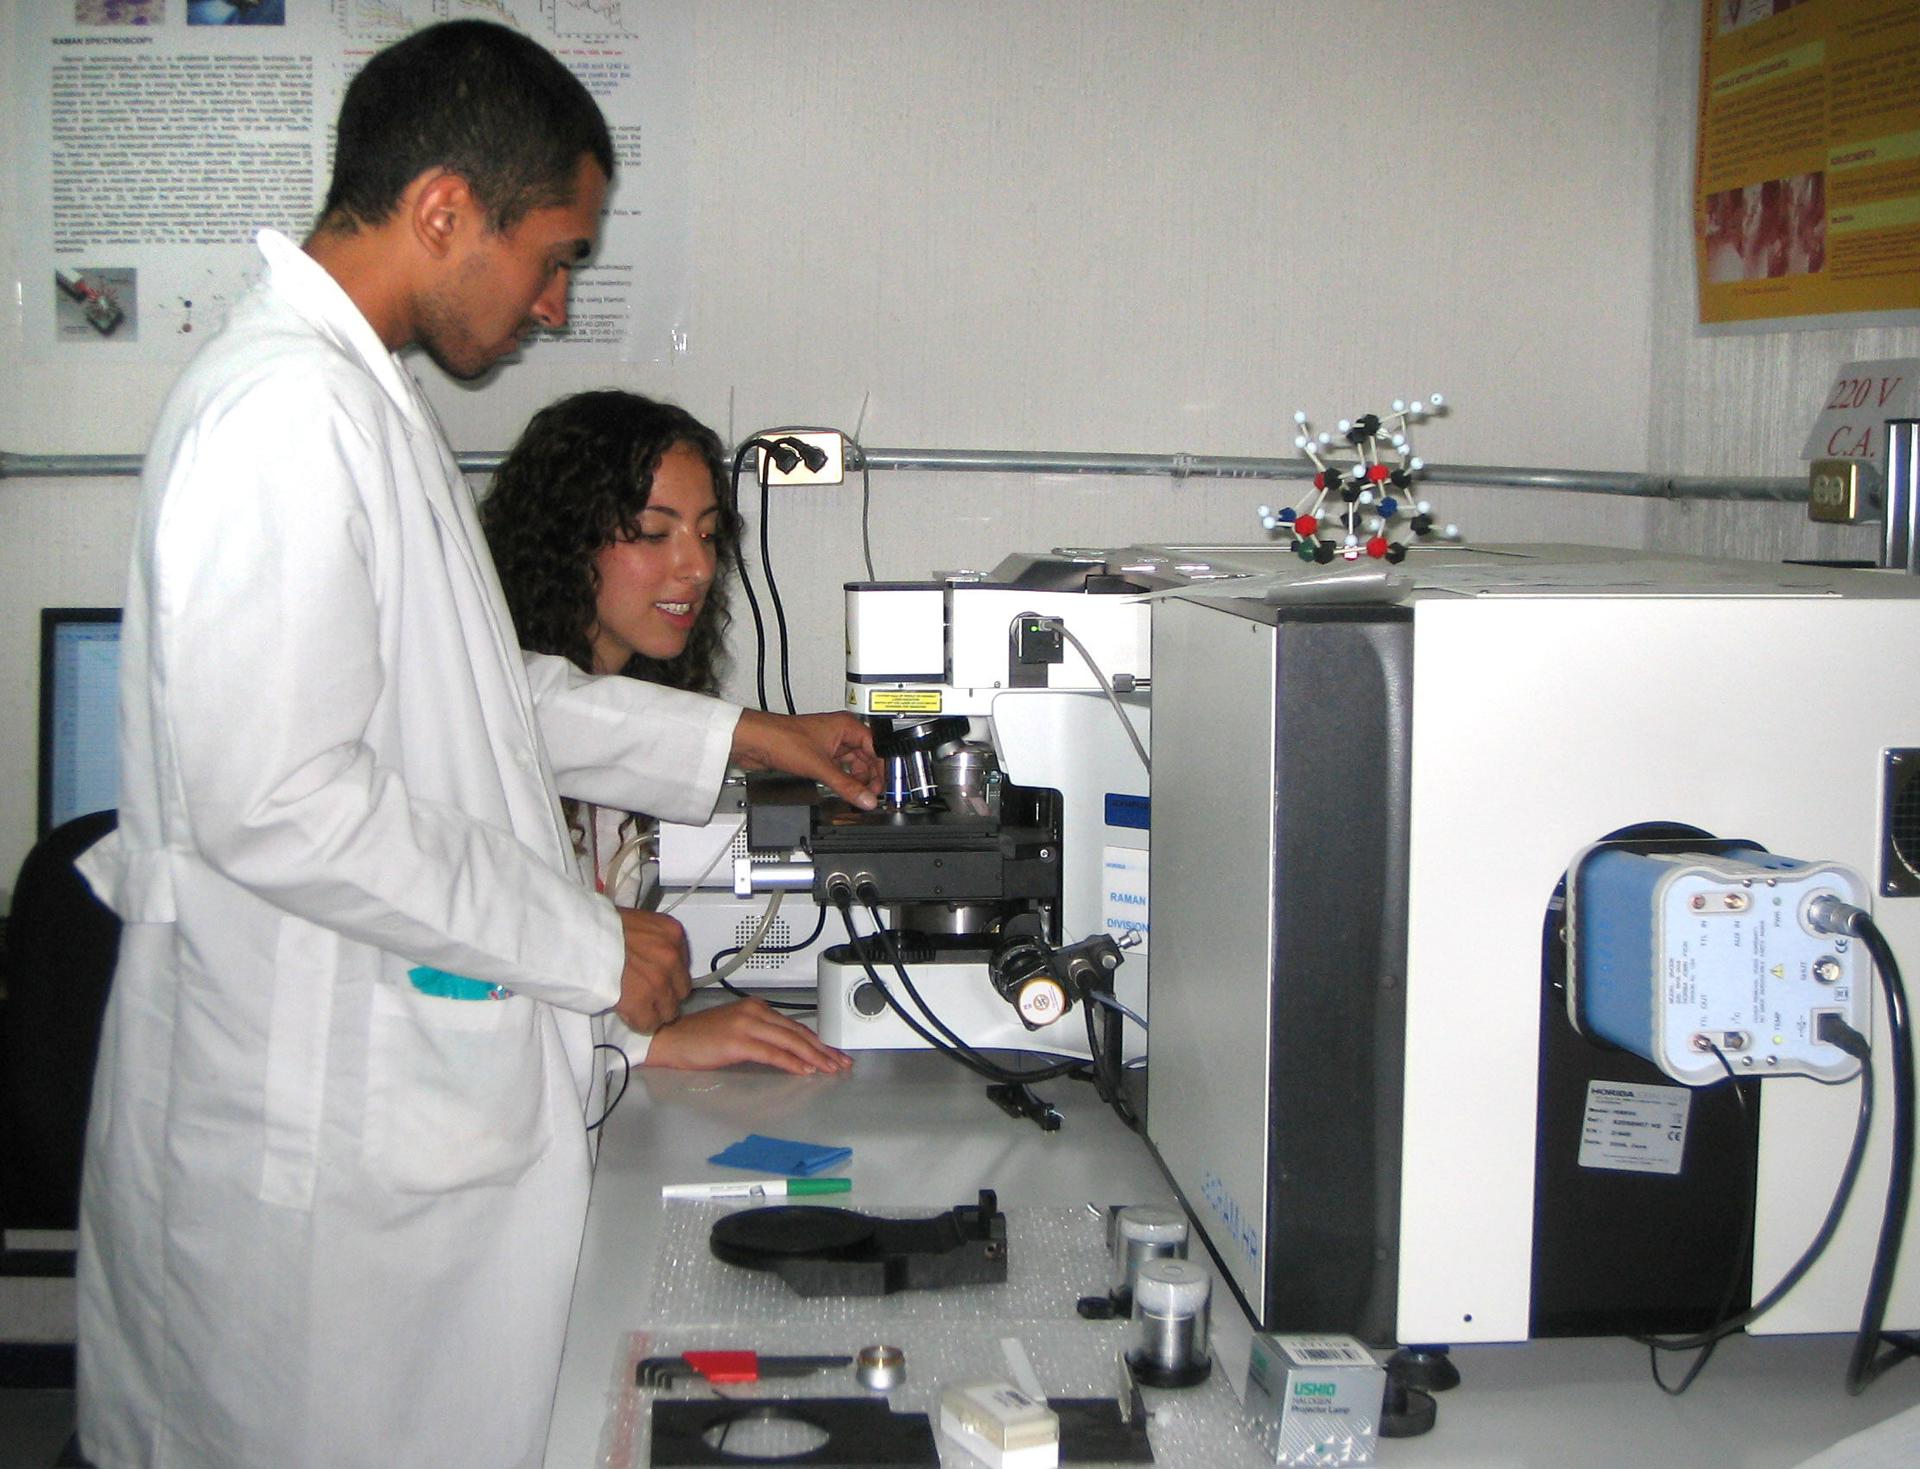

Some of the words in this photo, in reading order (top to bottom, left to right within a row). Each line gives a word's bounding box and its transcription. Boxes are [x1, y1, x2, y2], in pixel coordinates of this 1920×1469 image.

[85, 37, 153, 45] SPECTROSCOPY
[1826, 379, 1872, 410] 220
[1878, 377, 1904, 408] V
[1827, 425, 1875, 457] C.A.
[1110, 892, 1146, 906] RAMAN
[1106, 918, 1151, 933] DIVISION
[1294, 1382, 1336, 1396] USHIO
[1291, 1405, 1327, 1415] Projector
[1328, 1405, 1350, 1415] Lamp
